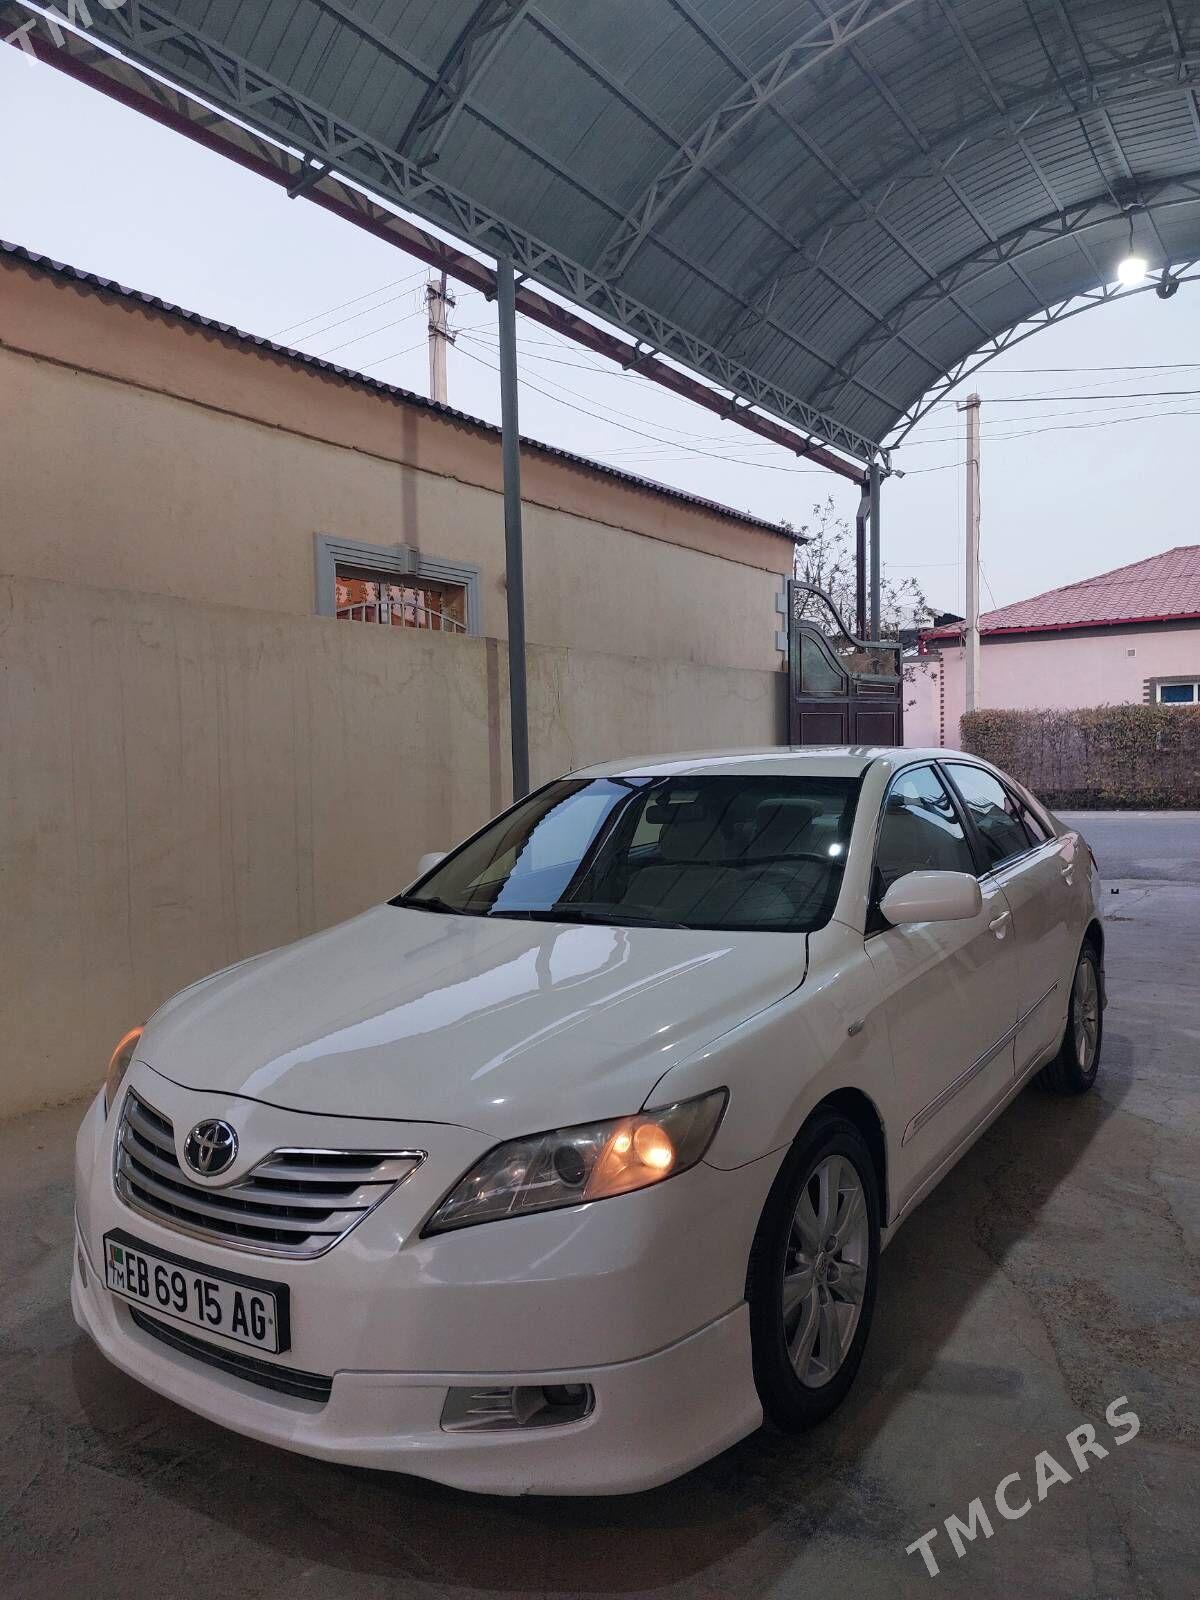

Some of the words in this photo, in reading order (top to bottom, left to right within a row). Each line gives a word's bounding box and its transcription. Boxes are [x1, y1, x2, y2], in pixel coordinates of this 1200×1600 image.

[110, 1262, 126, 1289] TM
[125, 1251, 150, 1298] EB
[154, 1265, 188, 1312] 69
[193, 1278, 222, 1325] 15
[231, 1292, 266, 1340] AG
